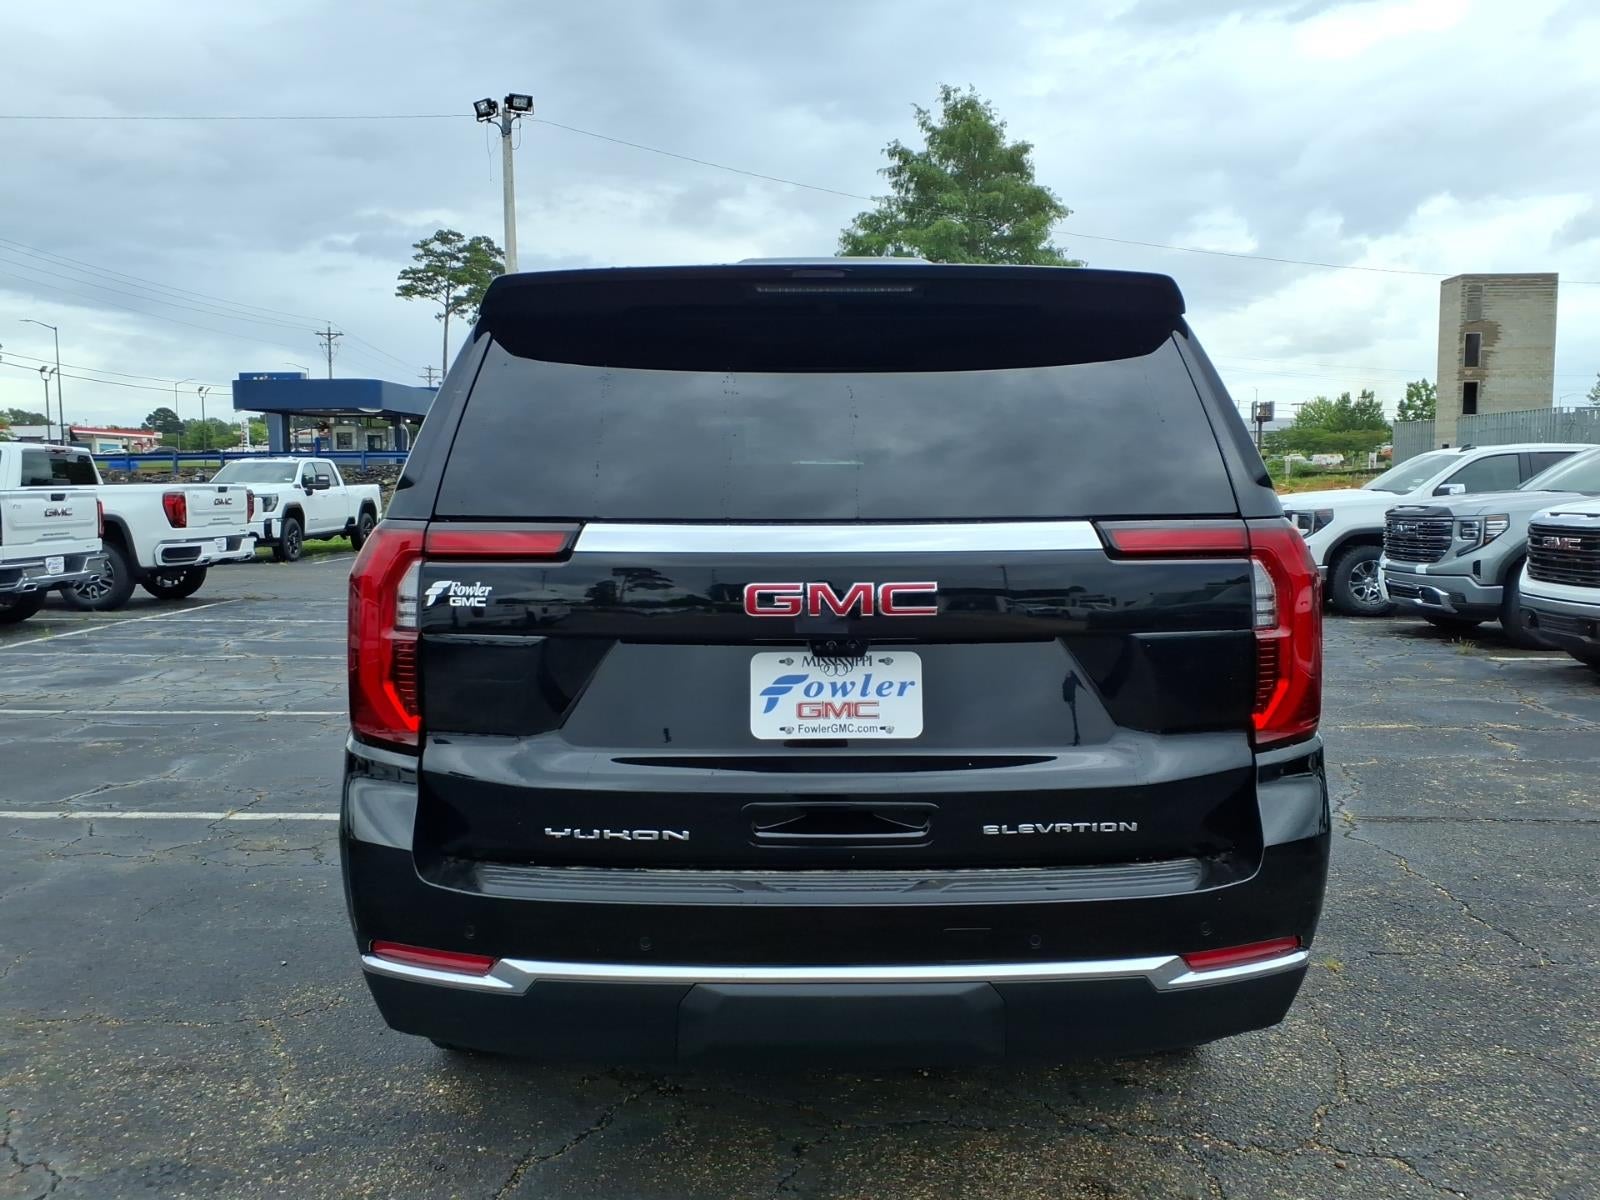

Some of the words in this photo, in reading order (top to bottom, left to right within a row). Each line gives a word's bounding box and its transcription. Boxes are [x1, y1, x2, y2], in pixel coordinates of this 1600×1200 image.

[214, 498, 232, 506] GMC
[44, 508, 72, 517] GMC
[1543, 536, 1582, 550] GMC
[448, 581, 492, 596] Fowler
[449, 597, 487, 607] GMC
[743, 581, 938, 617] GMC
[759, 673, 916, 714] Fowler
[796, 701, 880, 720] GMC
[797, 724, 879, 734] FowlerGMC.com
[543, 827, 690, 841] YUKON
[982, 821, 1139, 835] ELEVATION
